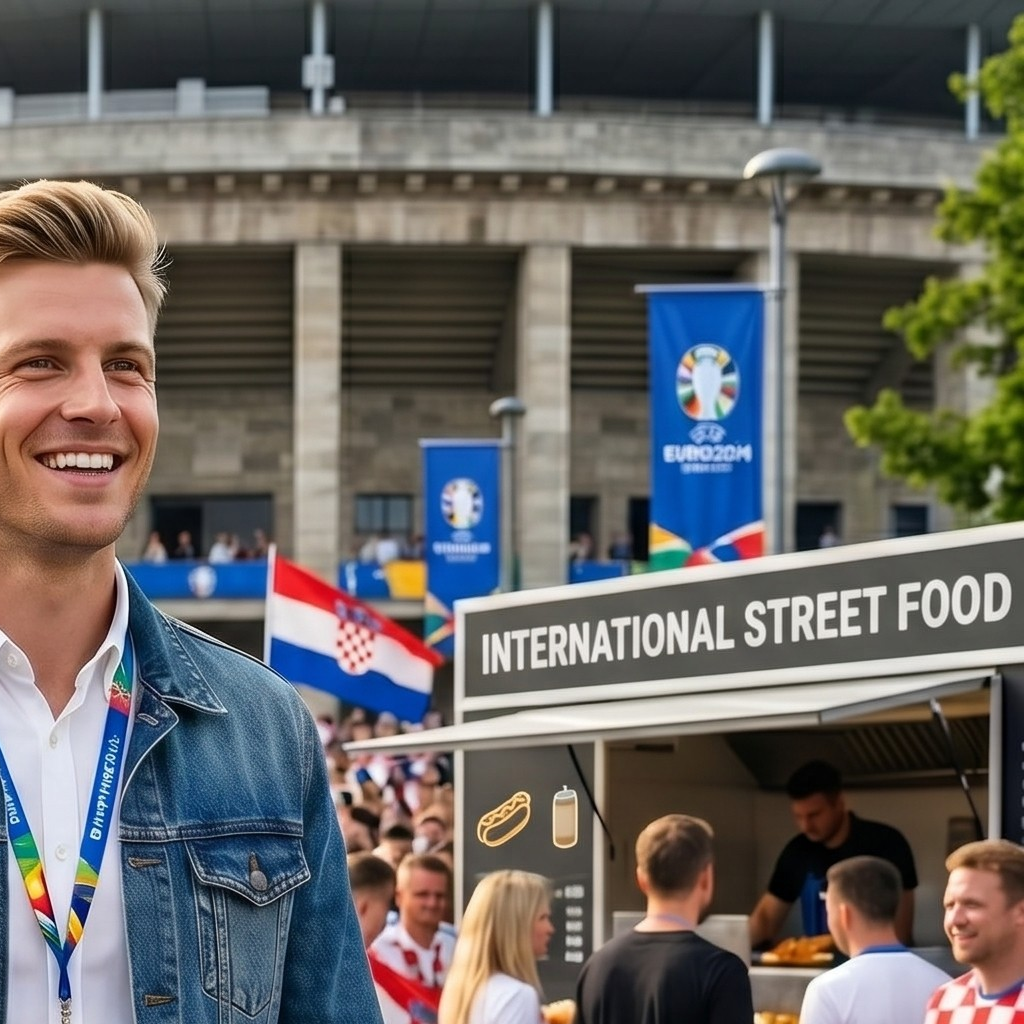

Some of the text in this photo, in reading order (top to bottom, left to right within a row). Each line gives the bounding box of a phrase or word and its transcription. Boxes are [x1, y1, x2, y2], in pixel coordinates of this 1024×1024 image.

[481, 572, 1013, 676] INTERNATIONAL STREET FOOD
